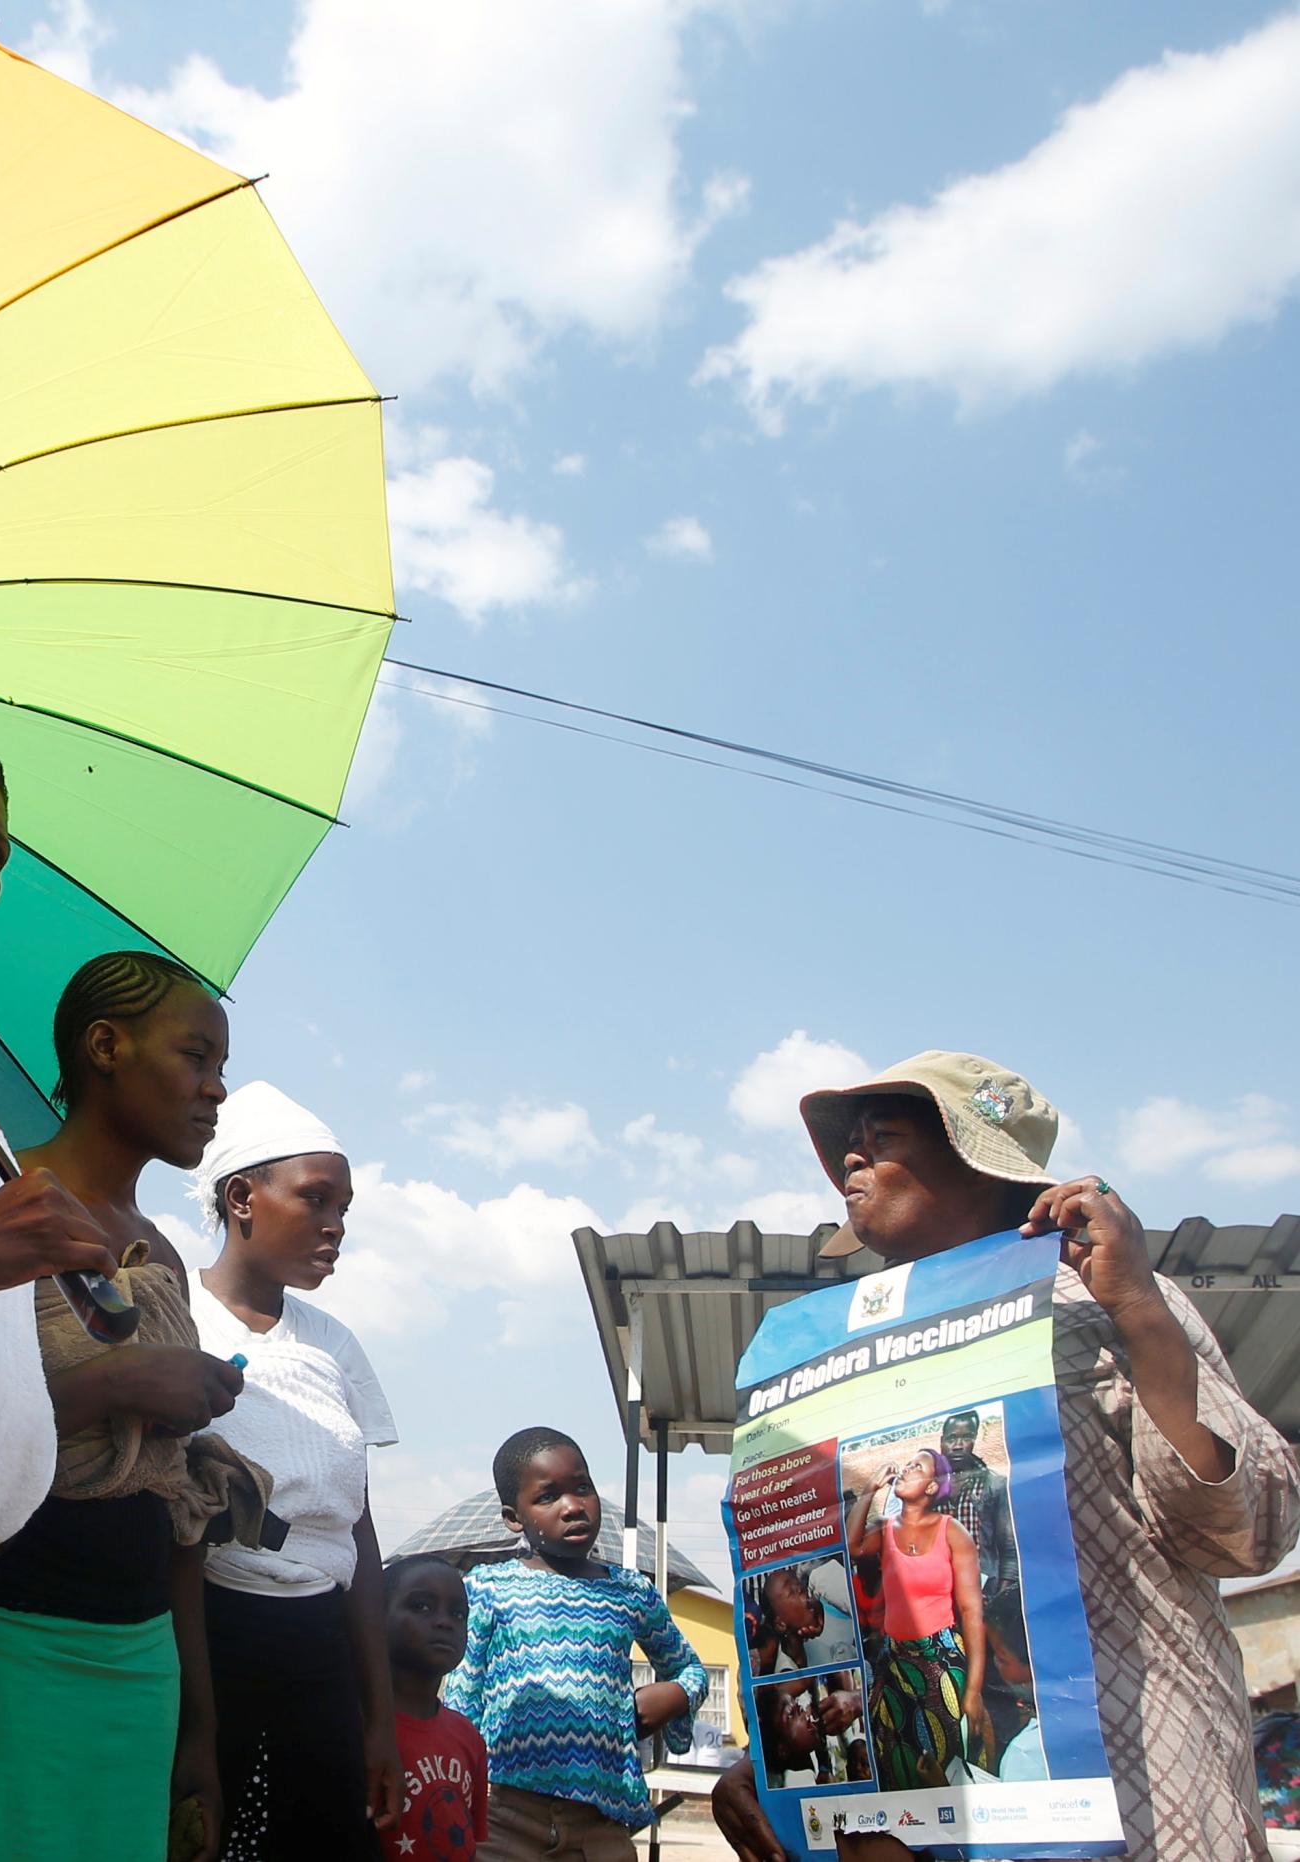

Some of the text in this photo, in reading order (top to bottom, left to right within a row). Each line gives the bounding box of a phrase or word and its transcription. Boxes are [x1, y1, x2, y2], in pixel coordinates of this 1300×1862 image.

[1191, 1275, 1282, 1288] OF ALL
[748, 1294, 1033, 1417] Oral Cholera Vaccination
[746, 1378, 906, 1444] Date: From to
[735, 1454, 812, 1488] For those above
[737, 1488, 817, 1523] Go to the nearest
[740, 1488, 761, 1505] year
[762, 1481, 773, 1495] of
[774, 1477, 793, 1492] age
[741, 1507, 827, 1541] vaccination center
[743, 1524, 834, 1561] for your vaccination
[858, 1813, 875, 1825] Gavi
[939, 1810, 952, 1820] JSI
[1048, 1799, 1080, 1809] unicef
